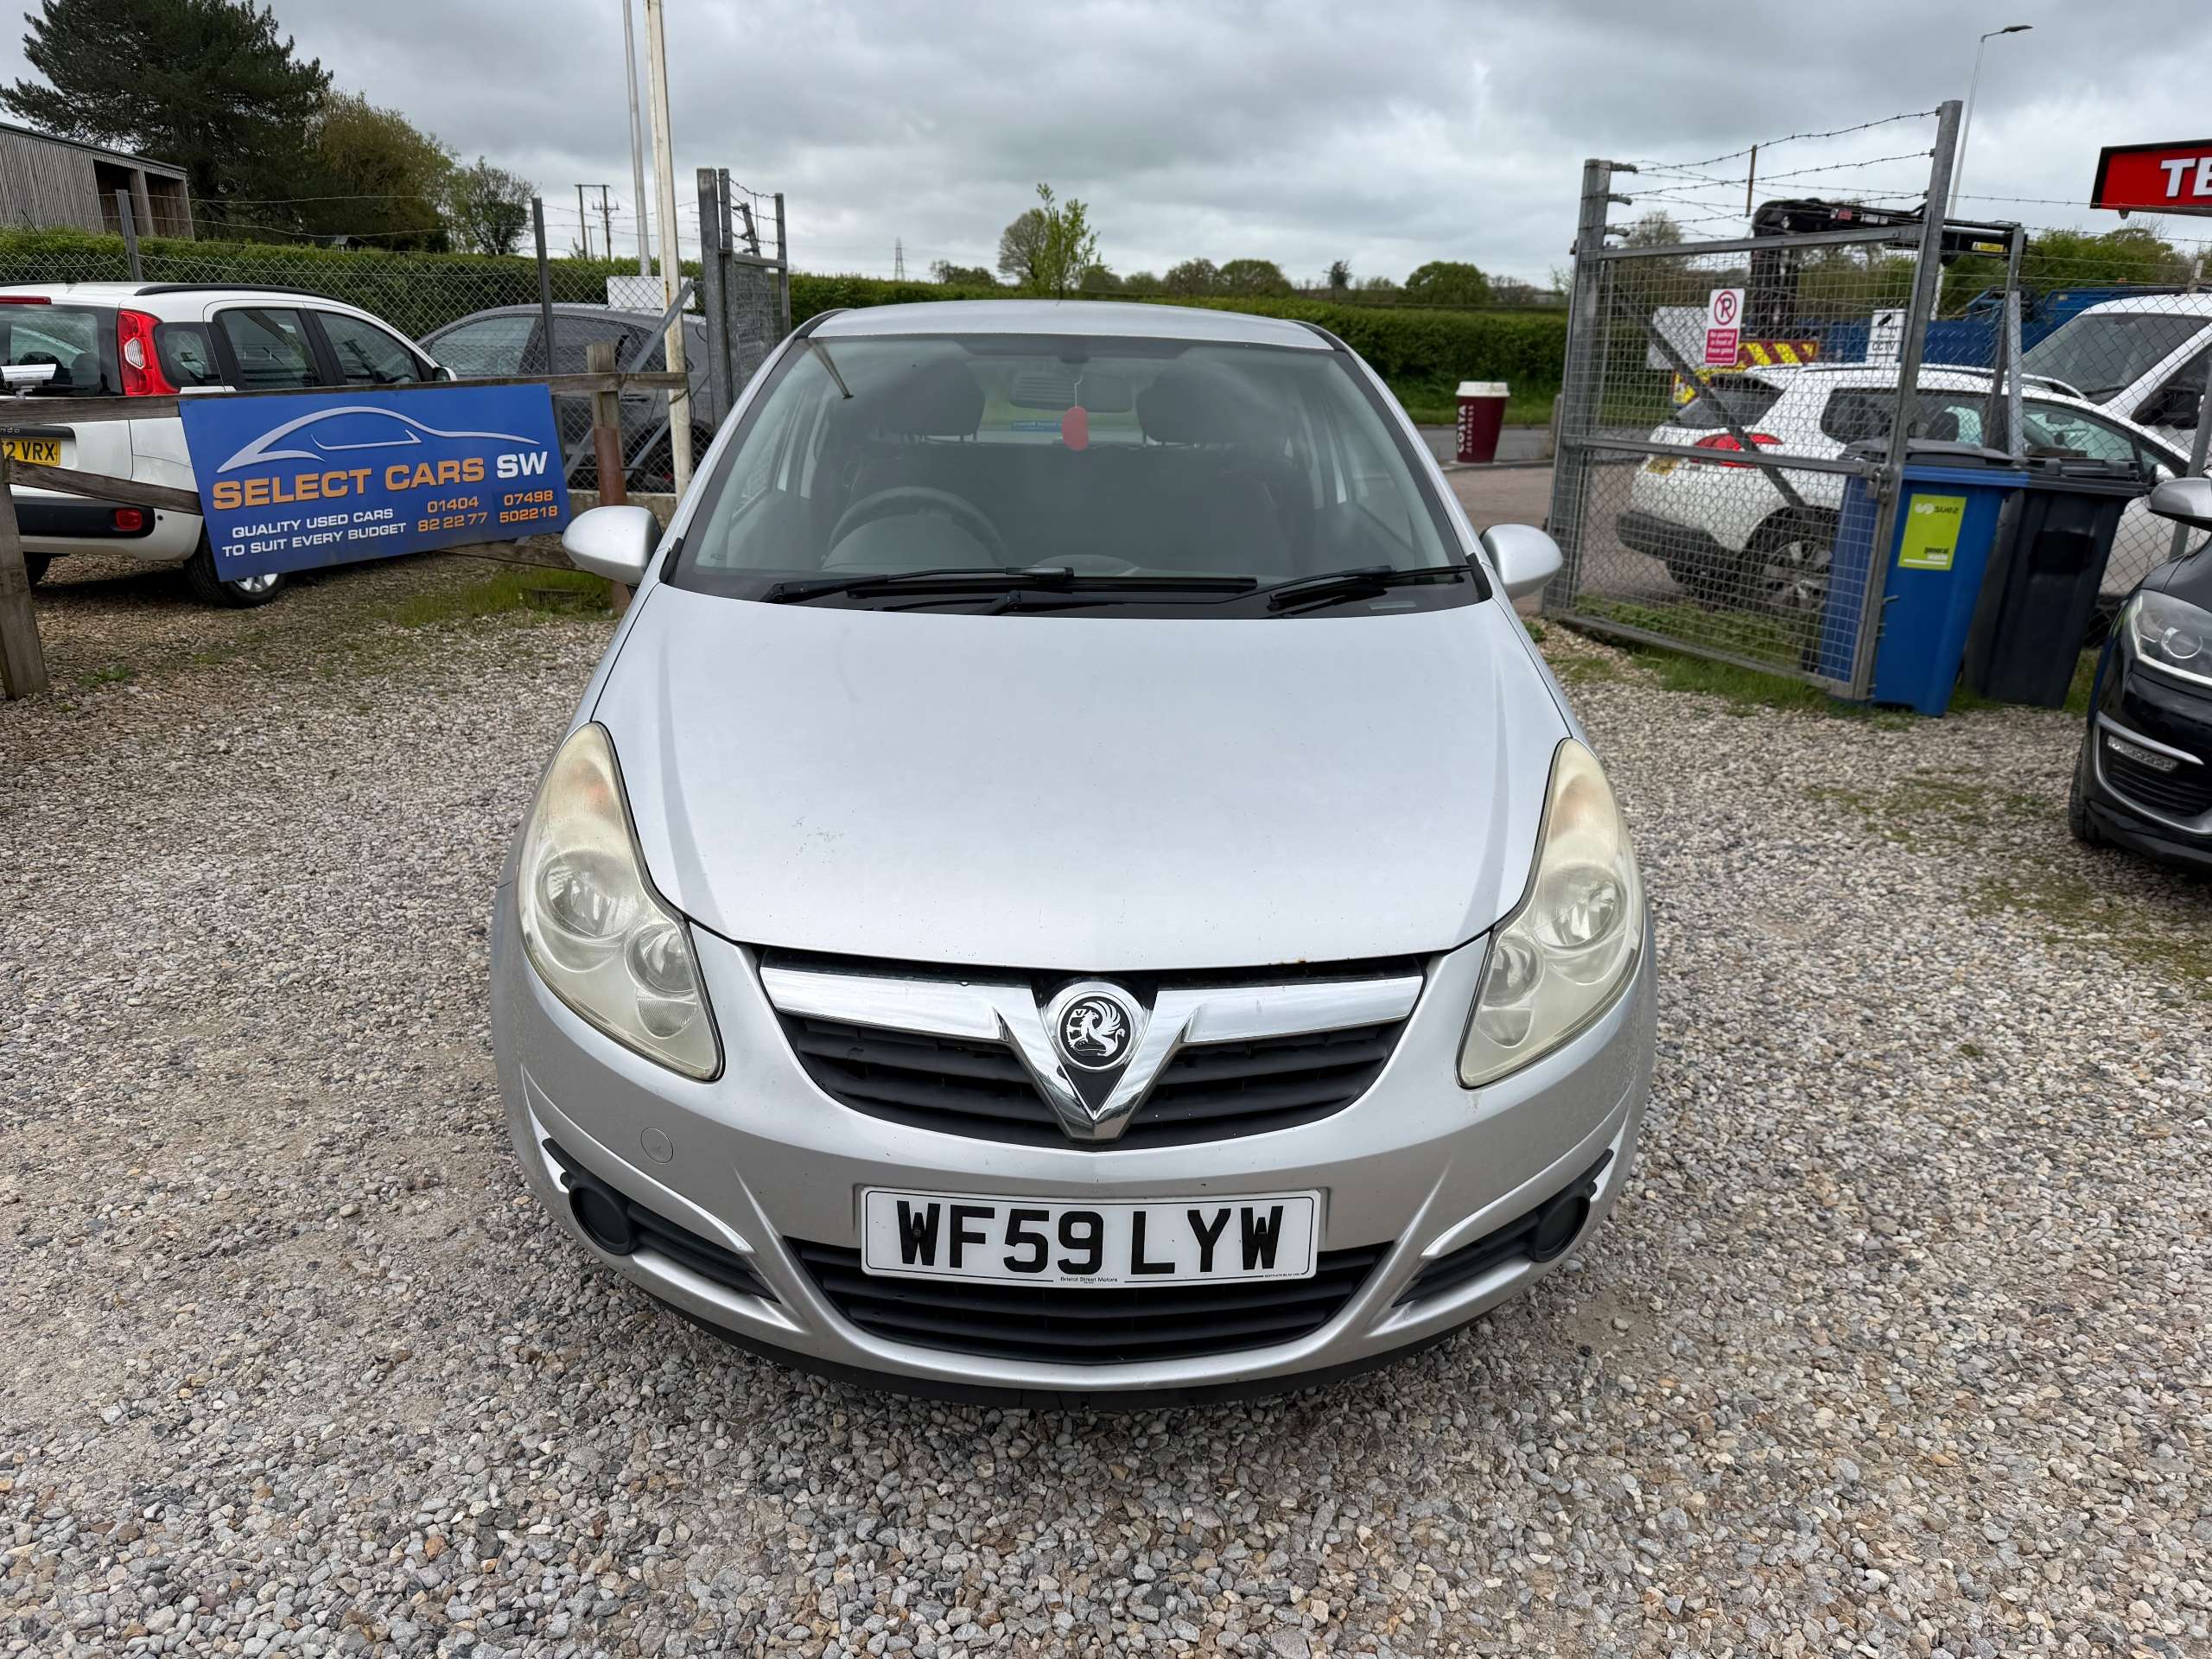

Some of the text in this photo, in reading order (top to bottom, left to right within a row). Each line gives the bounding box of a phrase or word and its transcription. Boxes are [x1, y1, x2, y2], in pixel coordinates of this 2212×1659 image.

[1872, 340, 1896, 351] CCTV
[1458, 405, 1466, 454] COSTA
[21, 442, 55, 461] VRX
[213, 451, 548, 510] SELECT CARS SW
[427, 496, 479, 513] 01404
[503, 490, 554, 506] 07498
[499, 505, 558, 523] 502218
[1934, 505, 1959, 514] suez
[232, 508, 394, 538] QUALITY USED CARS
[222, 522, 406, 557] TO SUIT EVERY BUDGET
[1924, 546, 1950, 555] general
[896, 1200, 1284, 1275] WF59 LYW
